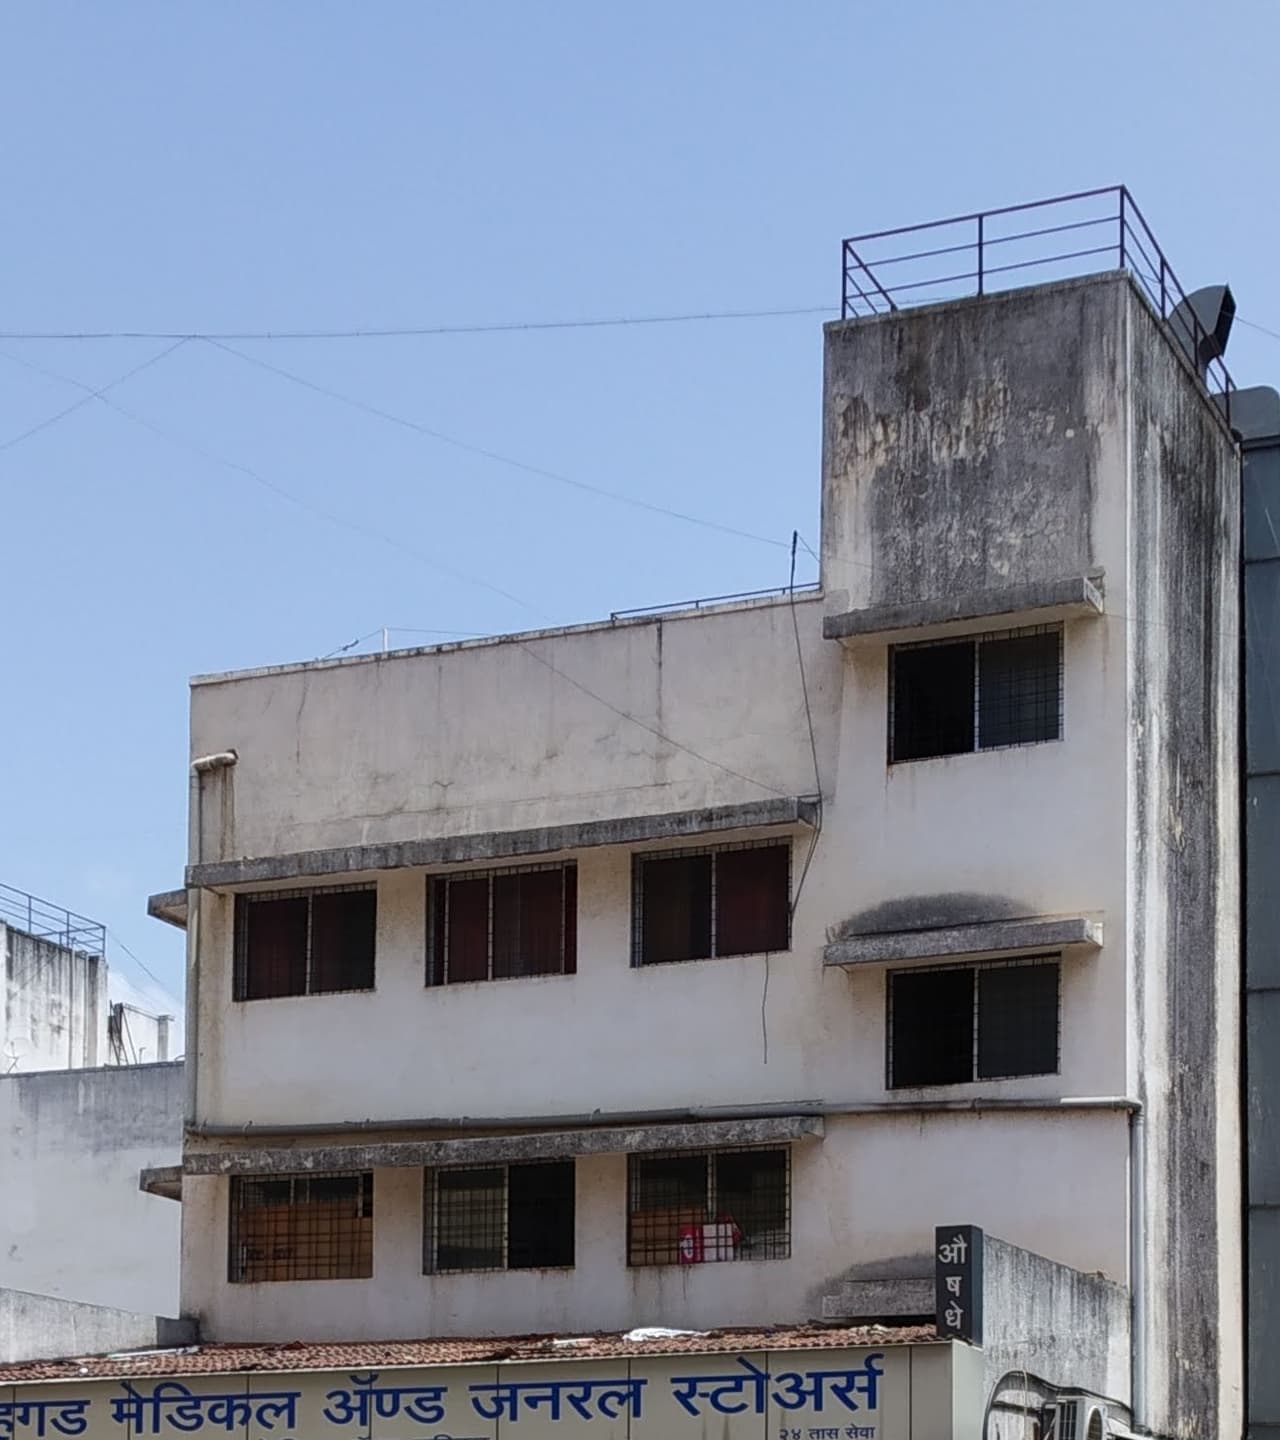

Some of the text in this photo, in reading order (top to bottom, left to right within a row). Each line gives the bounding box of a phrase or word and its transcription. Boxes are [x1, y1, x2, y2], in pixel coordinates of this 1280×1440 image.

[938, 1234, 968, 1329] औषधे
[110, 1381, 301, 1434] मेडिकल
[468, 1379, 648, 1422] जनरल
[671, 1353, 885, 1417] स्टोअर्स
[808, 1427, 840, 1440] तास
[845, 1423, 876, 1440] सेवा
